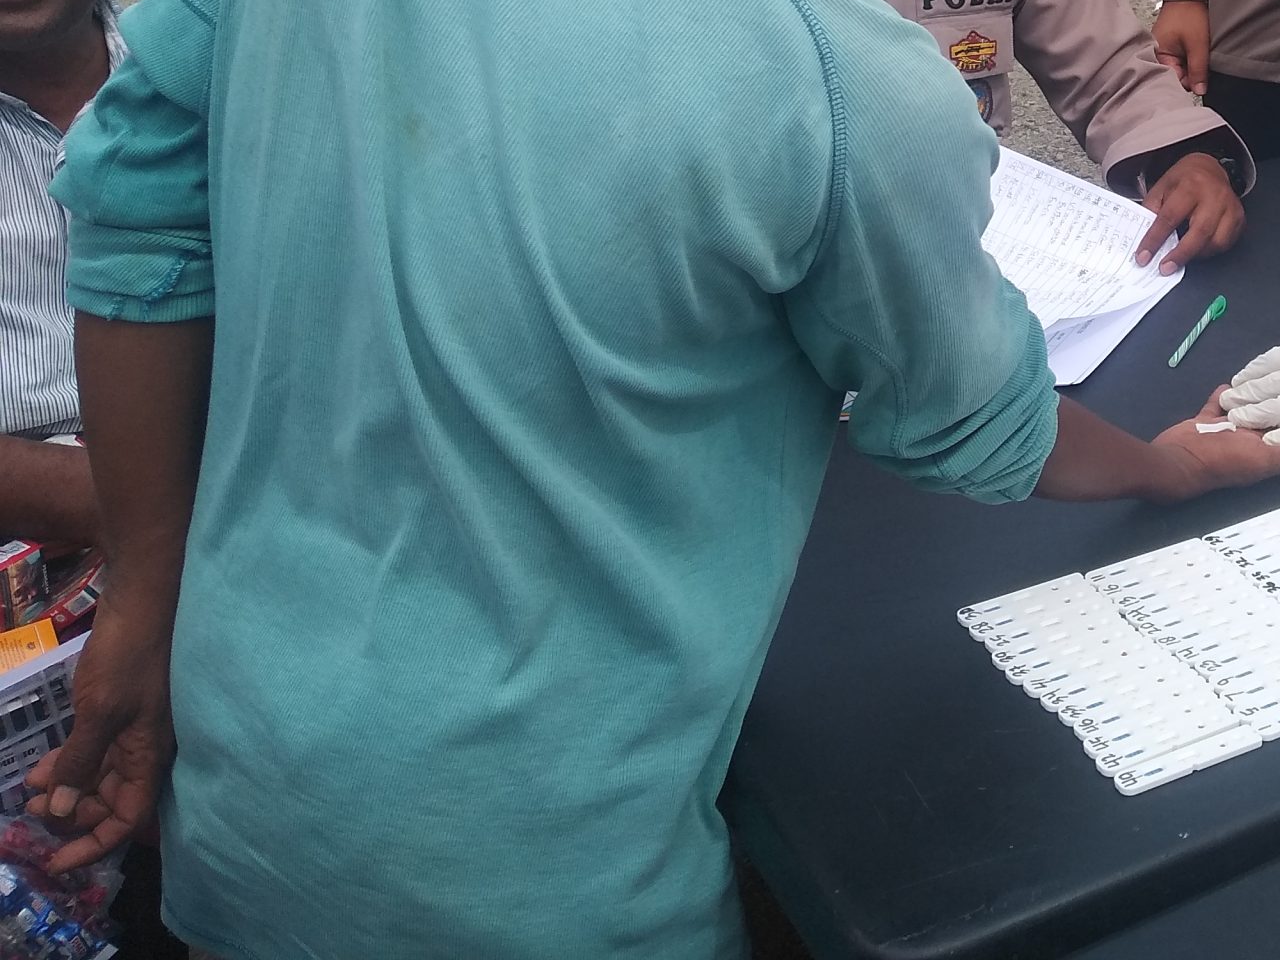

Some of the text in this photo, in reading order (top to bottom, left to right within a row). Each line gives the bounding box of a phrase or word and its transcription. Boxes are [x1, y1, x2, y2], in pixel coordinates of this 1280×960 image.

[1104, 584, 1122, 595] 16
[1119, 596, 1139, 607] 13
[971, 621, 993, 634] 28
[1140, 623, 1162, 634] 20
[1158, 636, 1181, 645] 18
[1178, 647, 1199, 659] 14
[1200, 660, 1221, 671] 23
[1101, 753, 1123, 768] 42
